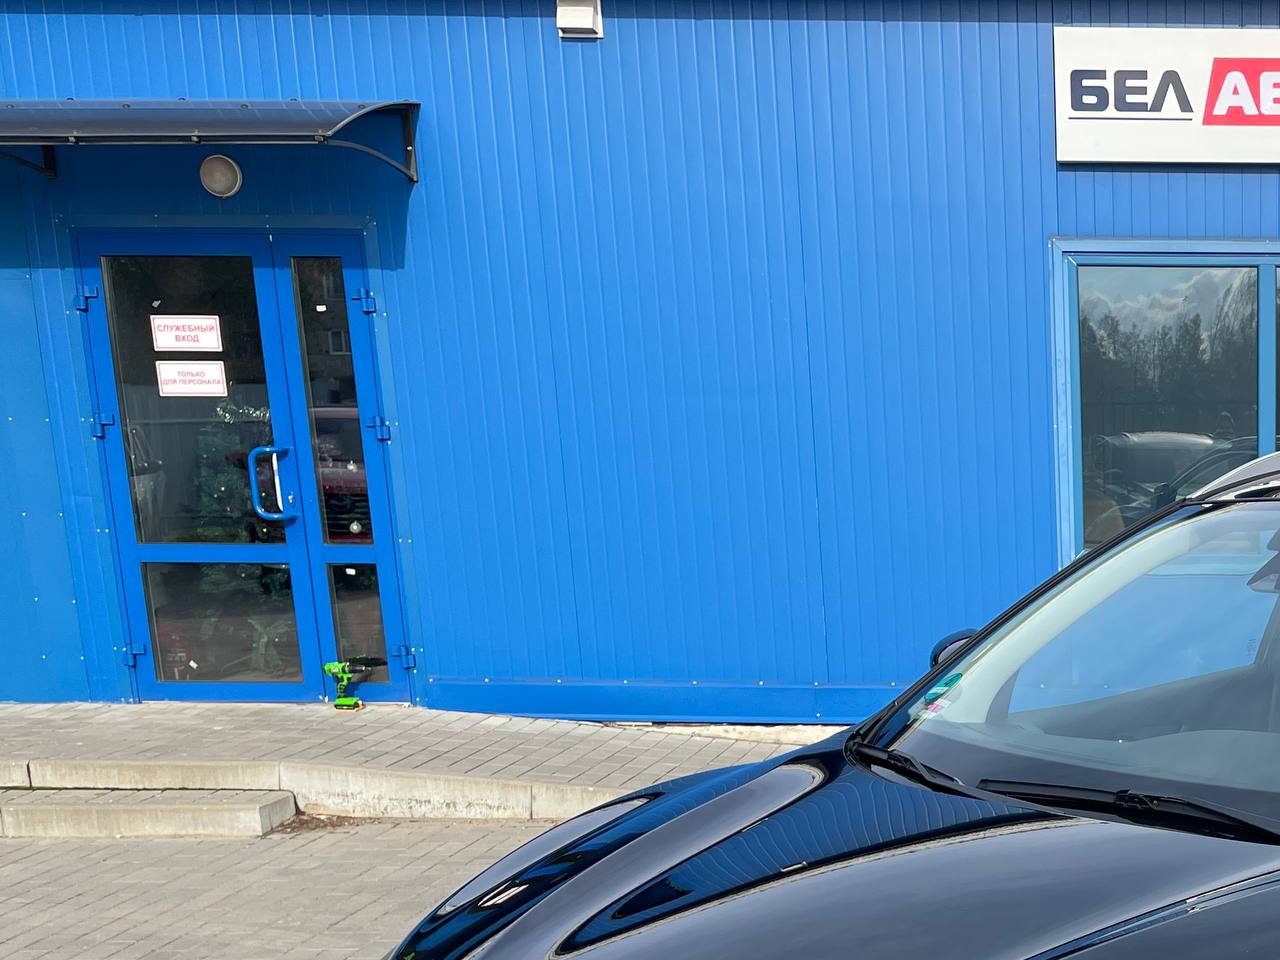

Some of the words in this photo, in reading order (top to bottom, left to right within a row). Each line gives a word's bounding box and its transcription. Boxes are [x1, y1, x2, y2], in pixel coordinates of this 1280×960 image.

[1069, 69, 1194, 113] БЕЛ
[157, 323, 215, 332] СЛУЖЕБНЫЙ
[175, 335, 200, 343] ВХОД
